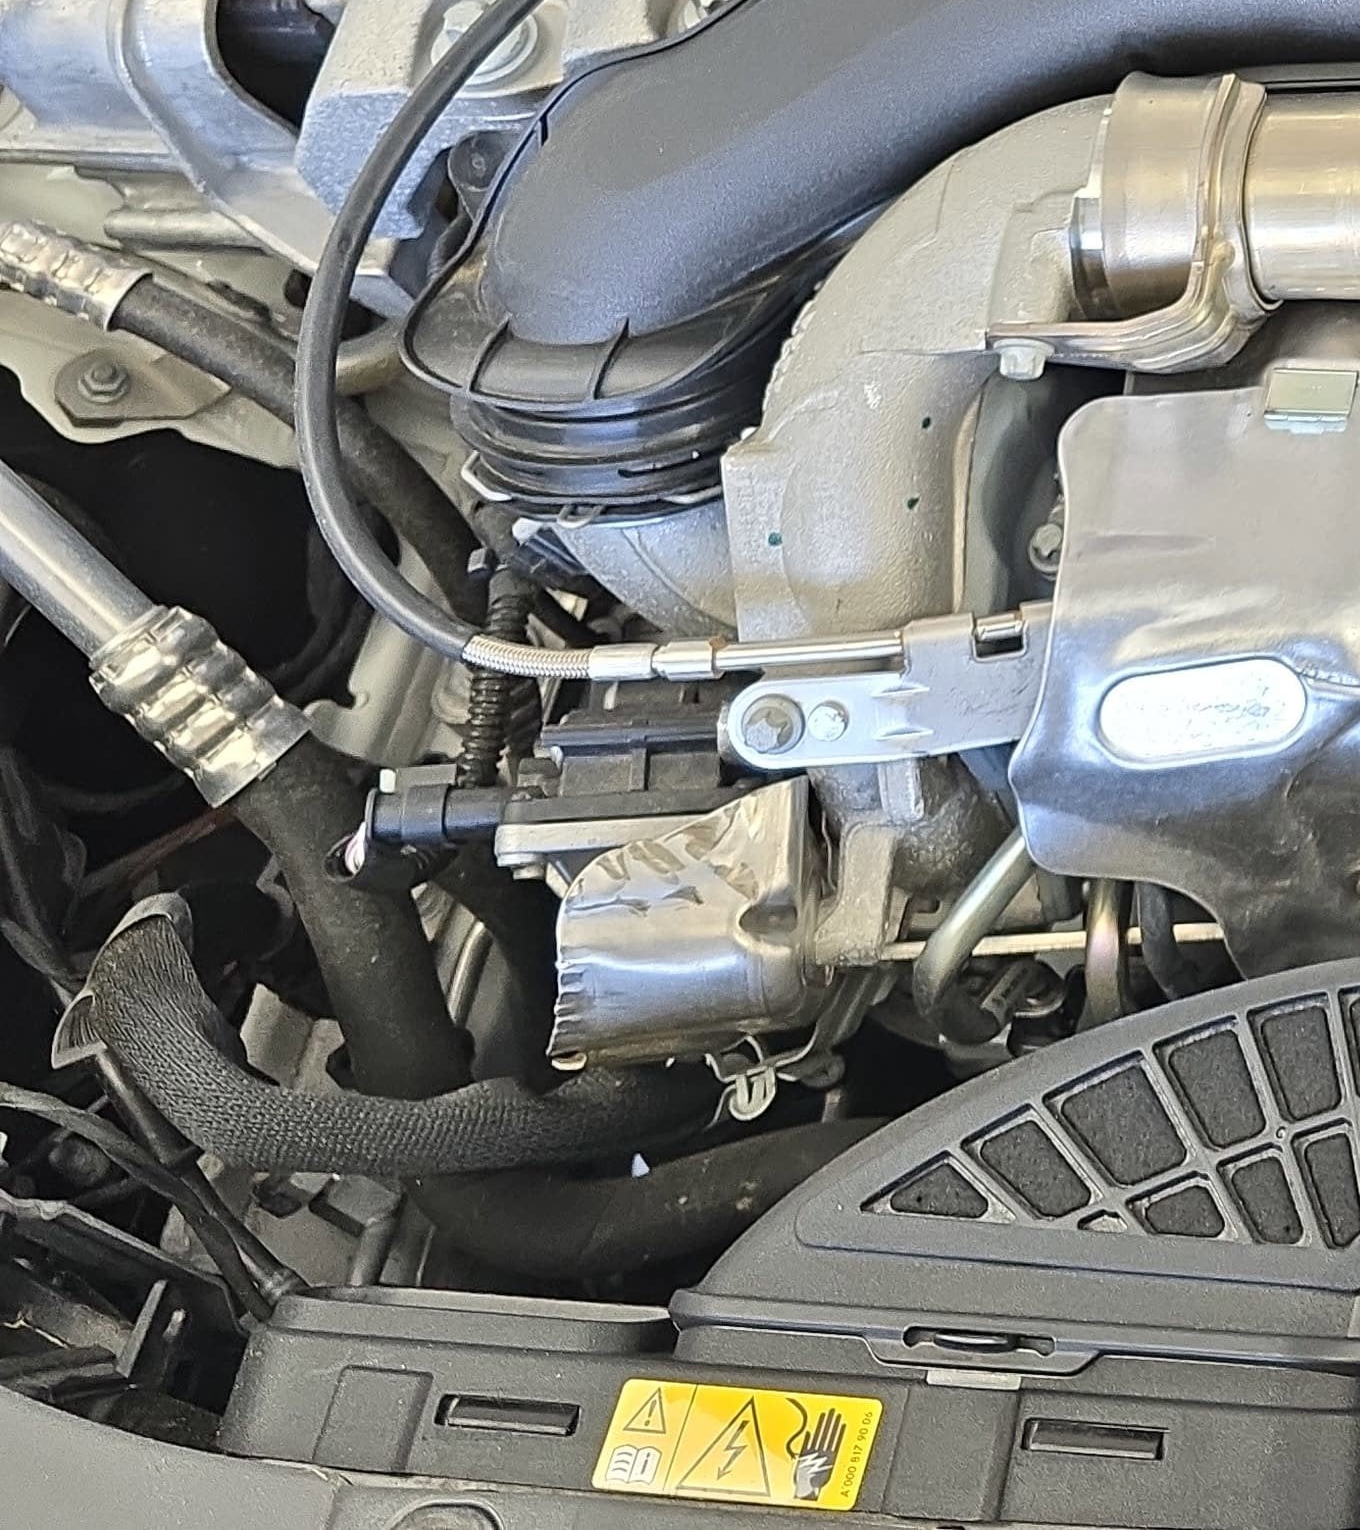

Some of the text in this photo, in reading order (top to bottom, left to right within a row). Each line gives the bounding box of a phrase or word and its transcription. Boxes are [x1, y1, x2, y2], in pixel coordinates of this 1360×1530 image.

[862, 1412, 873, 1425] 06
[857, 1428, 868, 1441] 90
[850, 1444, 863, 1463] 817
